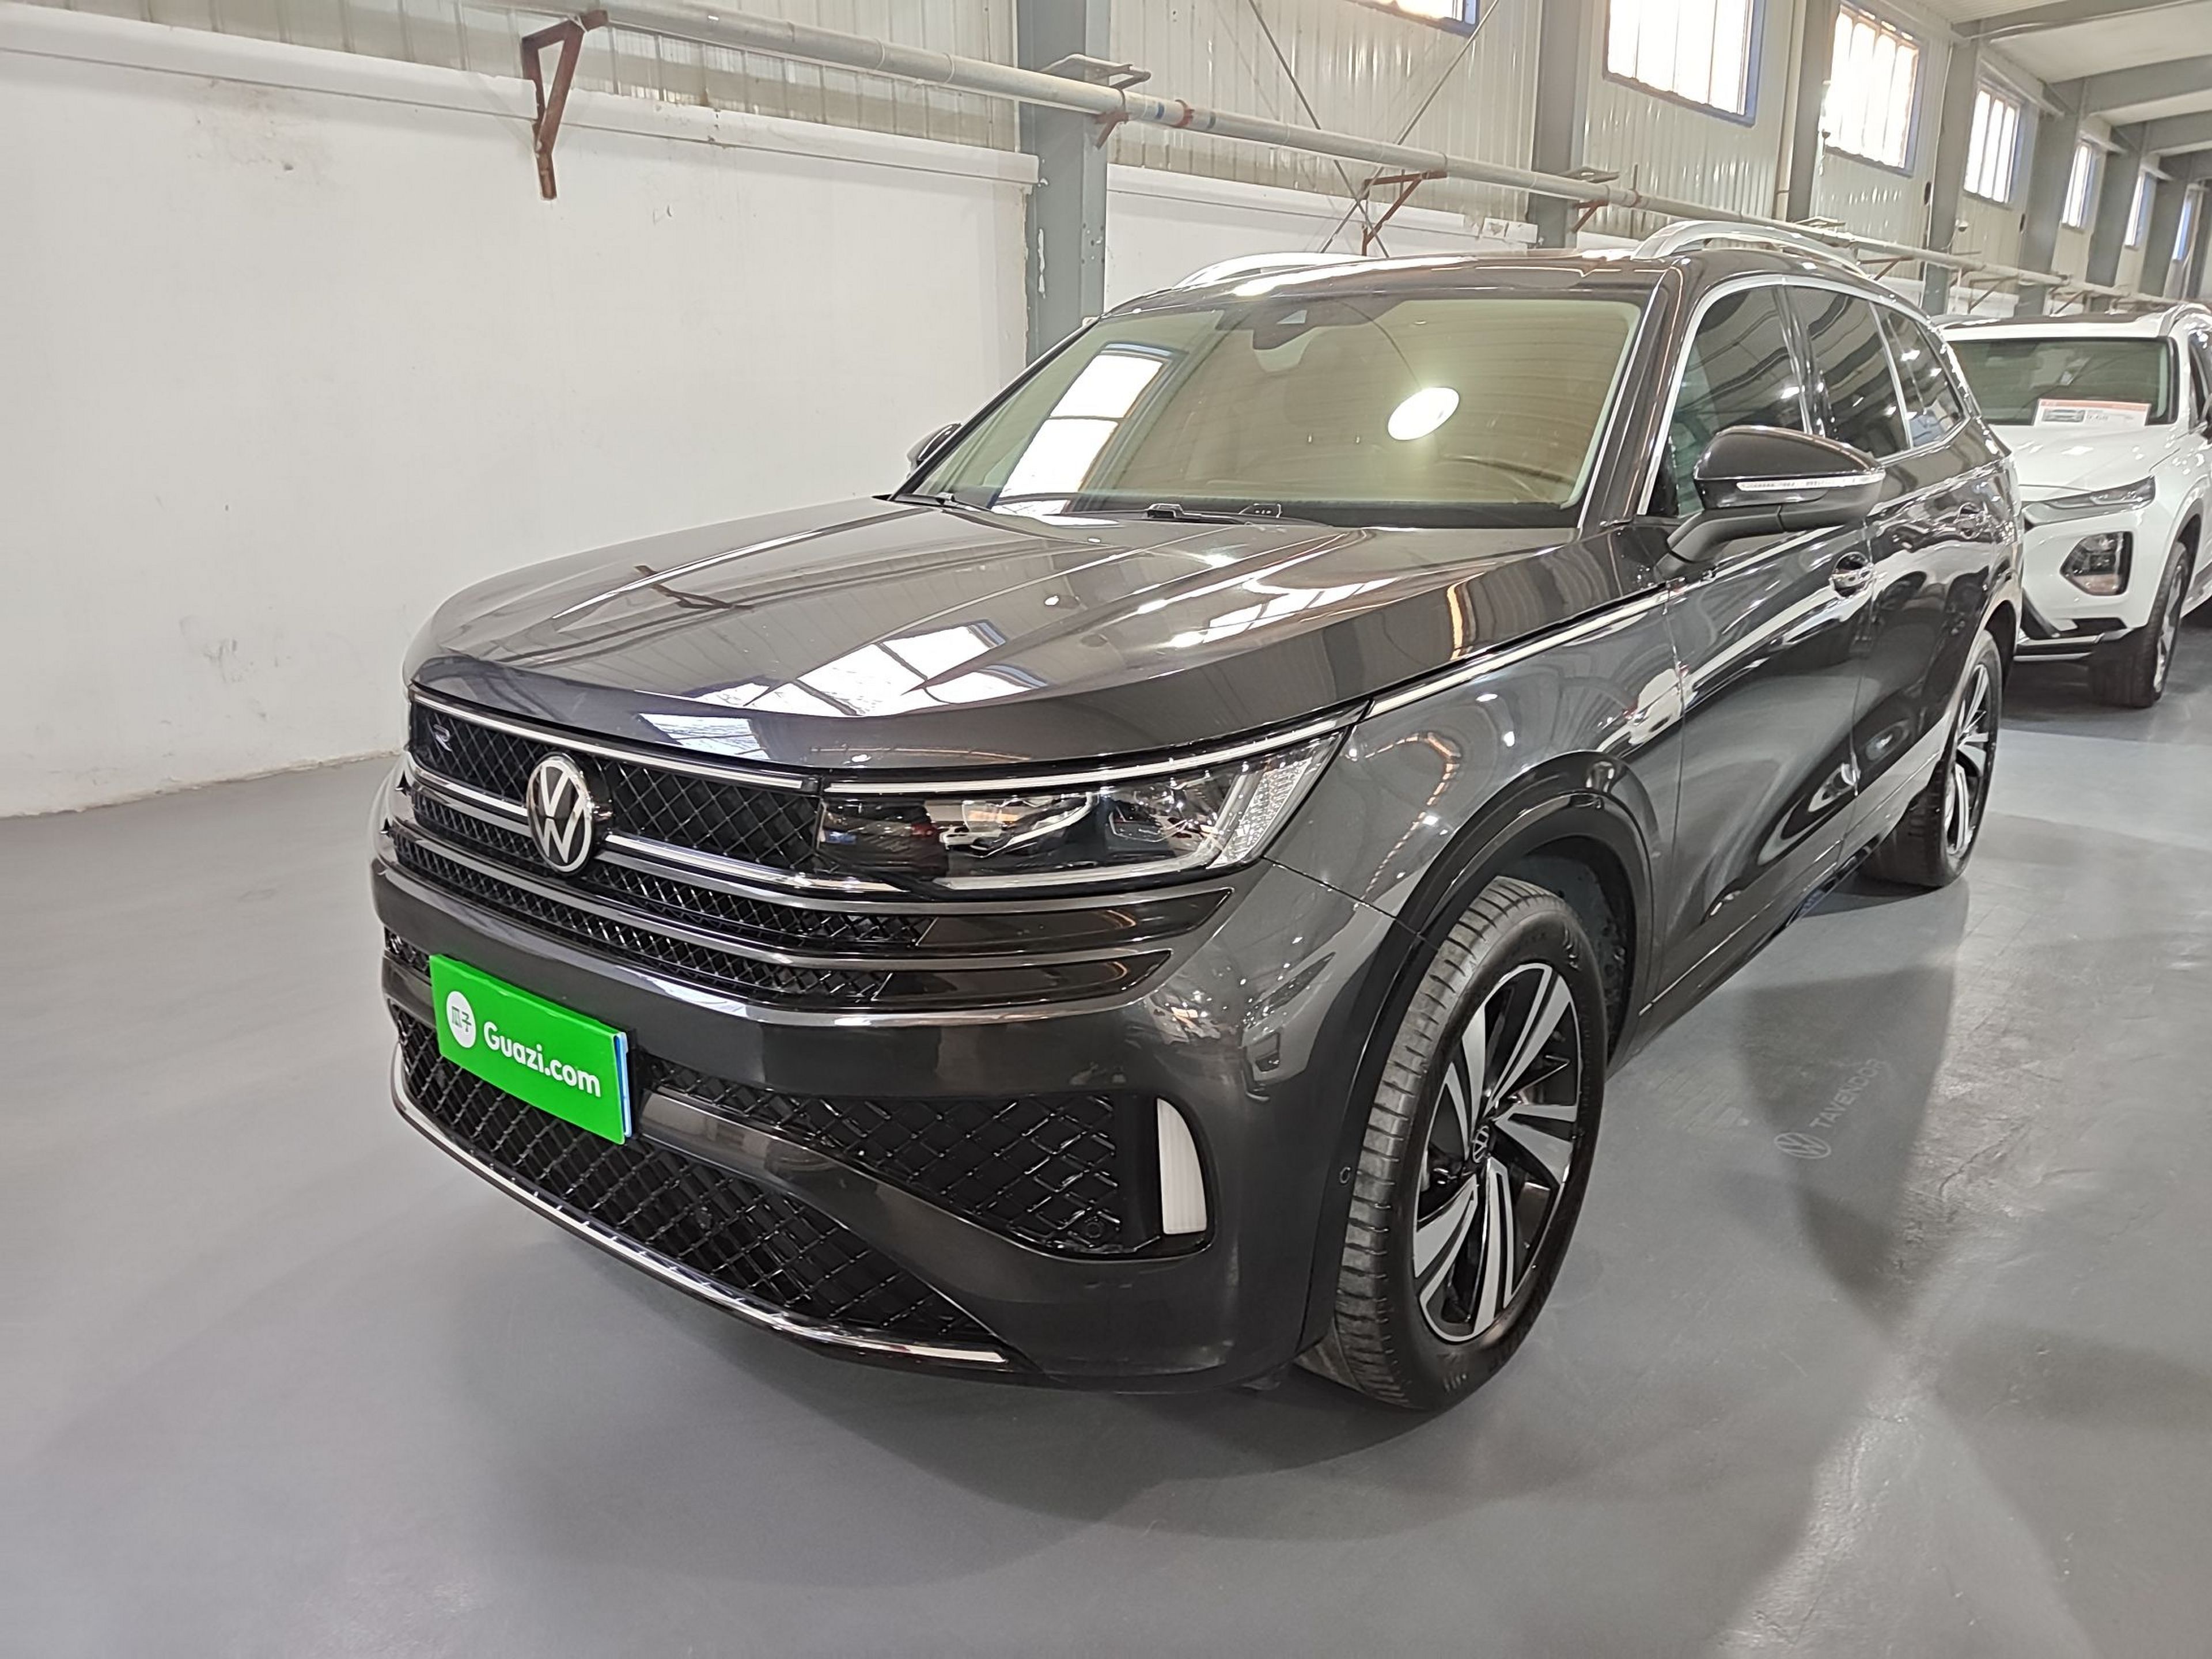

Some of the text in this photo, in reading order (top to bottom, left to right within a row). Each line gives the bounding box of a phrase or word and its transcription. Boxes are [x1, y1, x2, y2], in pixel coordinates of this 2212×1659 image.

[433, 724, 452, 752] R
[483, 1021, 601, 1098] Guazi.com
[1809, 1058, 1887, 1128] TAVENDOR
